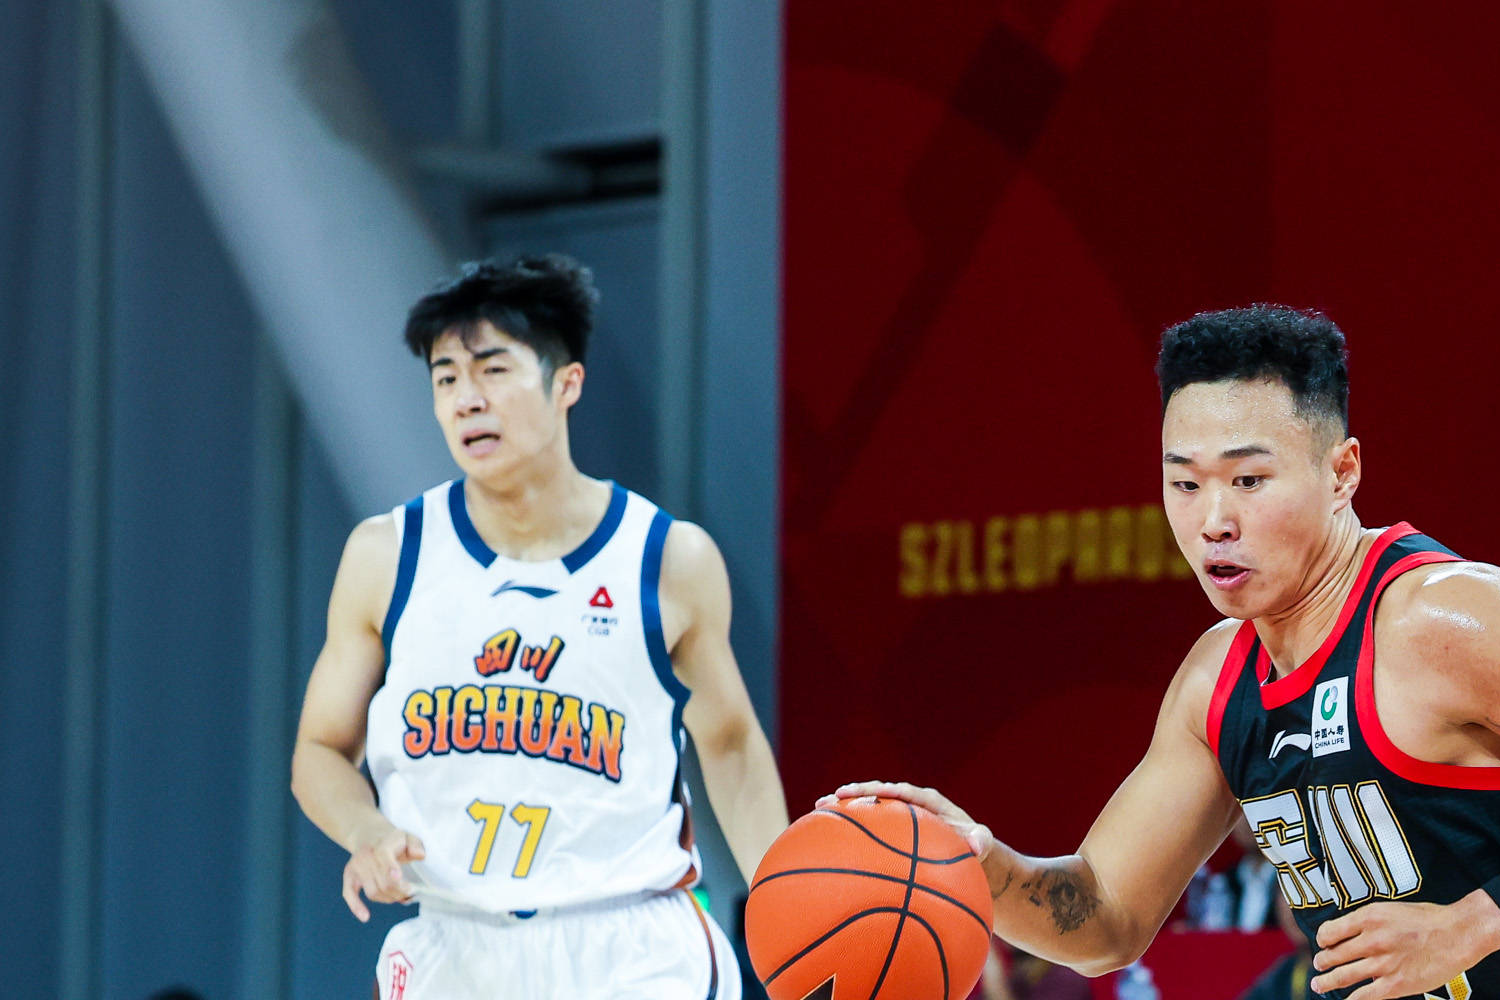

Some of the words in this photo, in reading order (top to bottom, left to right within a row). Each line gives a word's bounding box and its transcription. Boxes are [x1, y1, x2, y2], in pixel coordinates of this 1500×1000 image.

[402, 682, 626, 784] SICHUAN
[1314, 740, 1331, 750] CHINA
[1331, 737, 1345, 745] LIFE
[466, 798, 551, 879] 77
